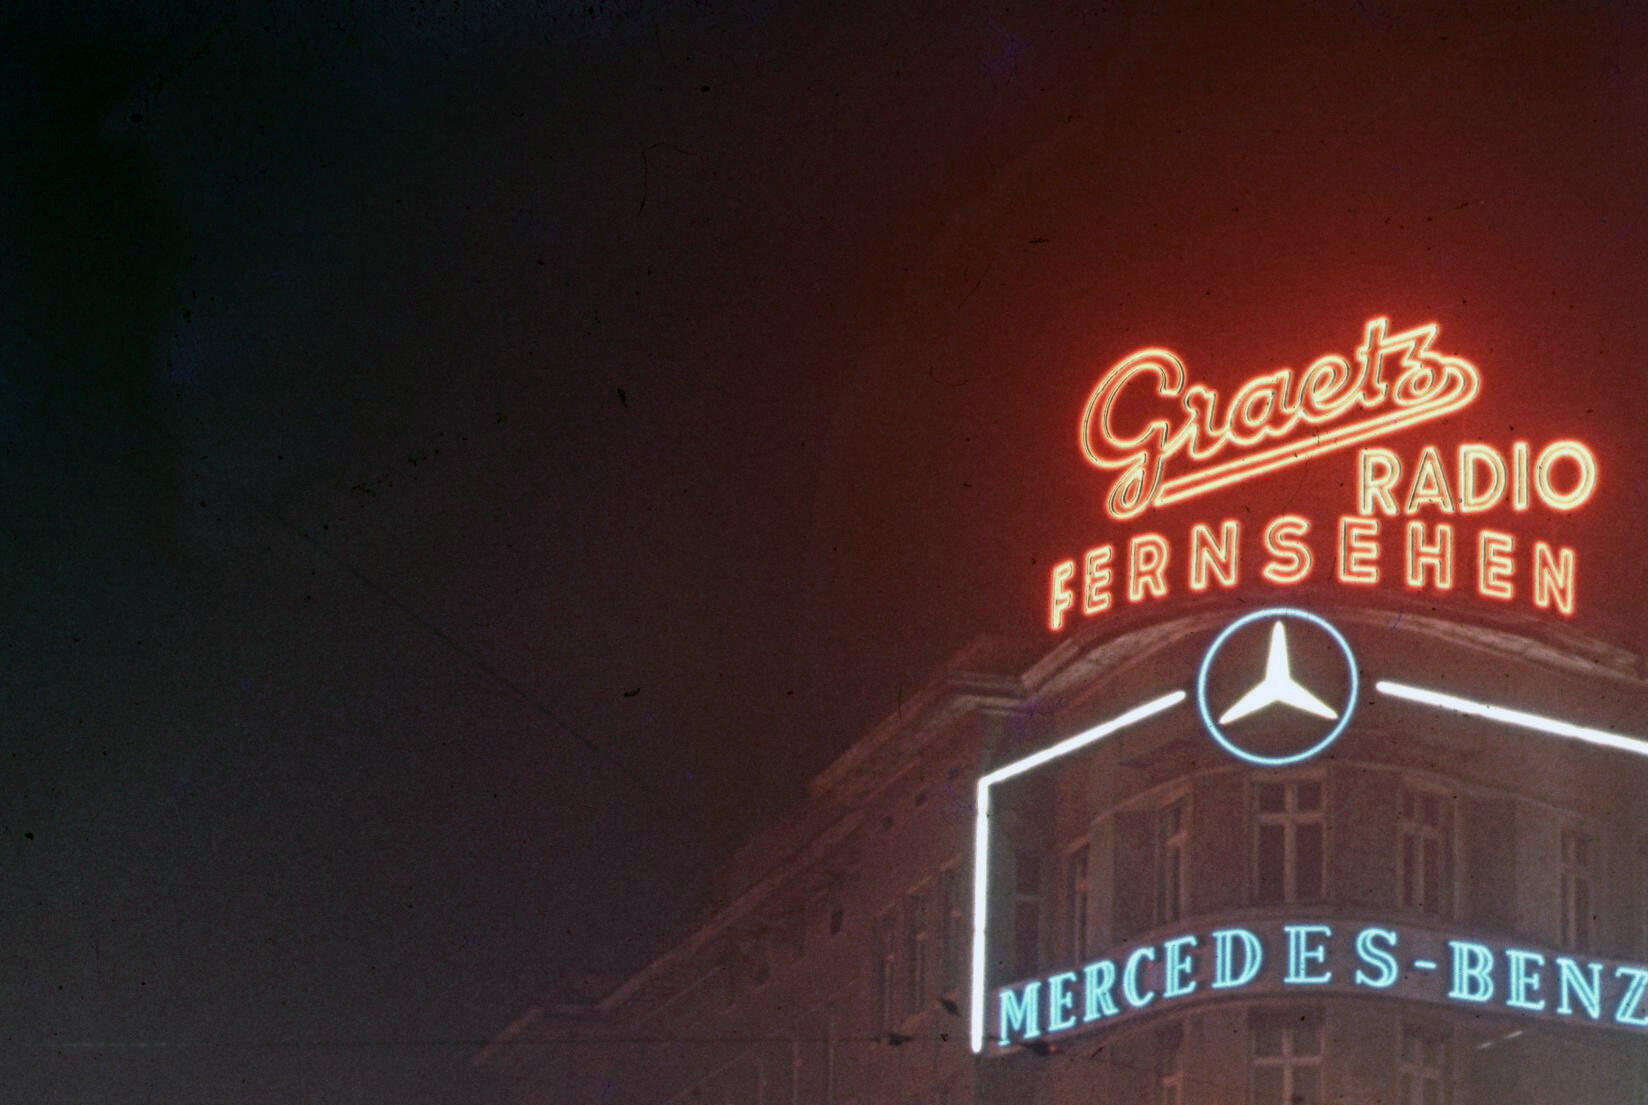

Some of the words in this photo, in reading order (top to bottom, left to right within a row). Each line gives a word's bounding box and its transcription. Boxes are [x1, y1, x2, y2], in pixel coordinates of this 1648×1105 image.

[1081, 316, 1481, 519] Graetz
[1360, 440, 1596, 515] RADIO
[1048, 516, 1577, 632] FERNSEHEN
